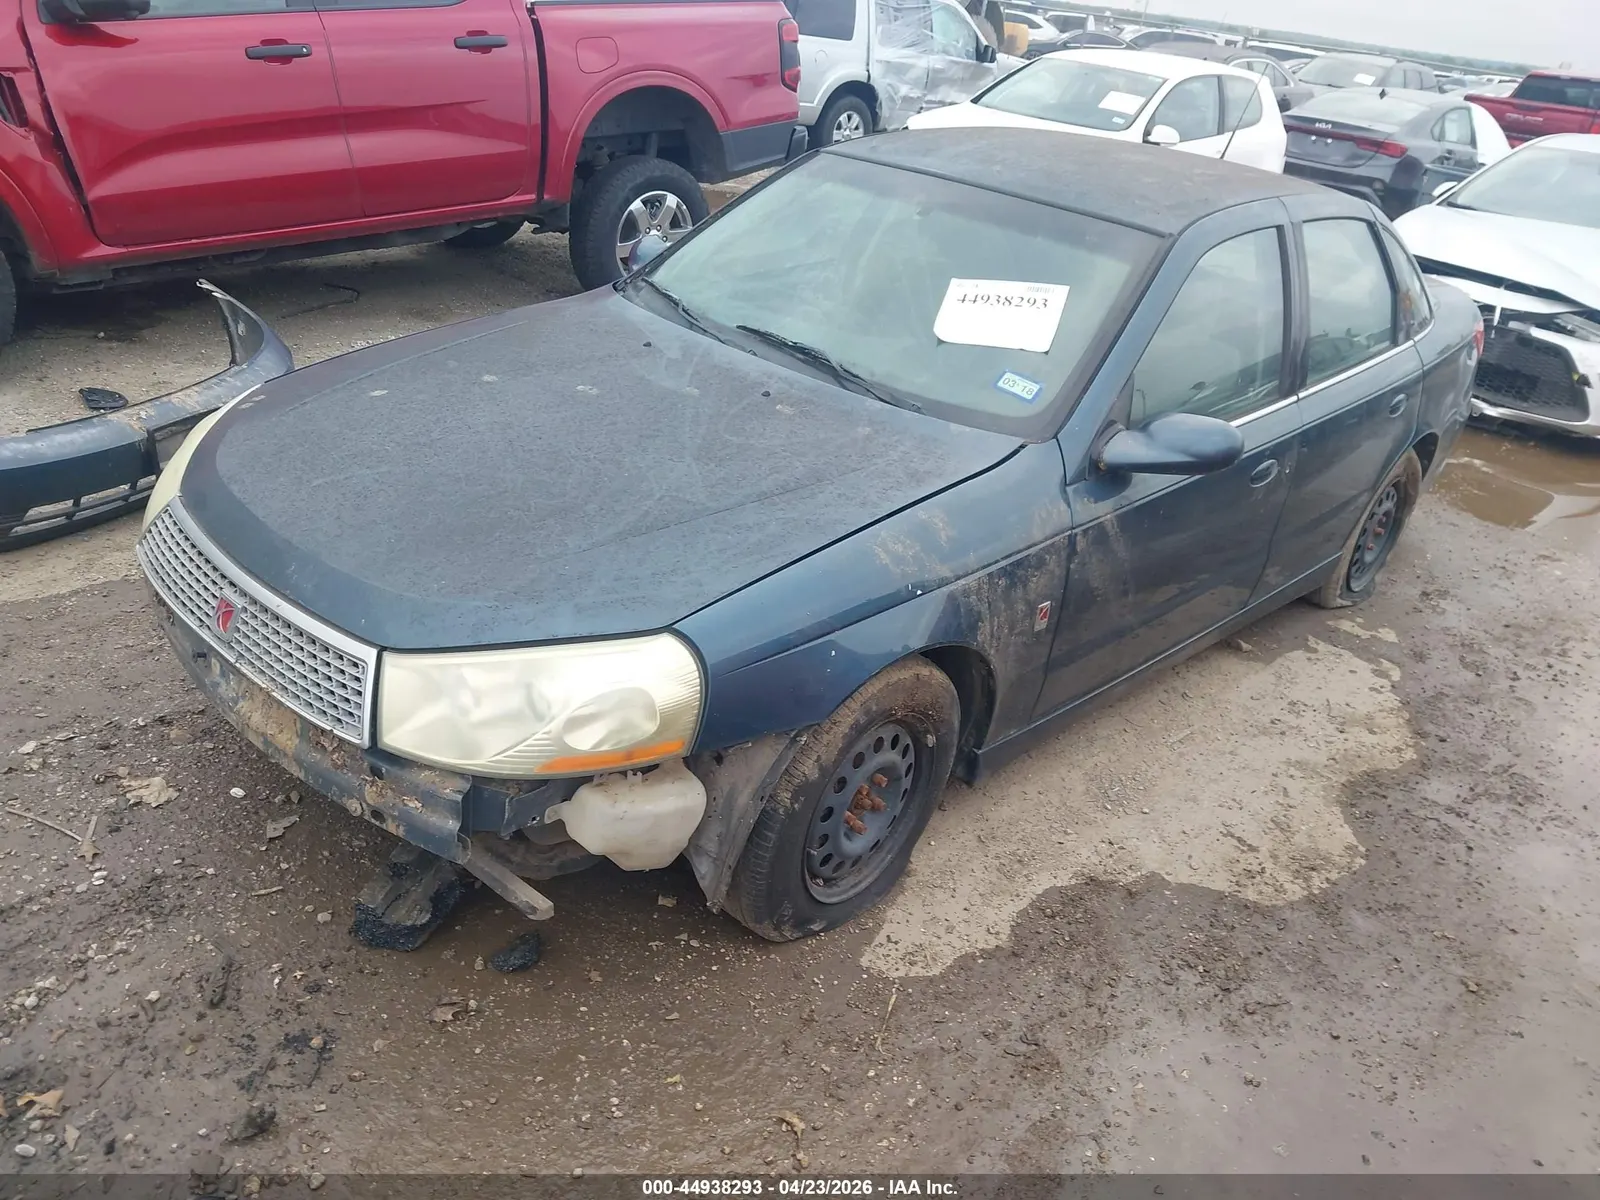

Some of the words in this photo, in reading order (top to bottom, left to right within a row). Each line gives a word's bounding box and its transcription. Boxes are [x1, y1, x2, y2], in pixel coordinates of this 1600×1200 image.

[957, 293, 1048, 310] 44938293
[1002, 377, 1017, 388] 03
[1021, 385, 1035, 396] 18
